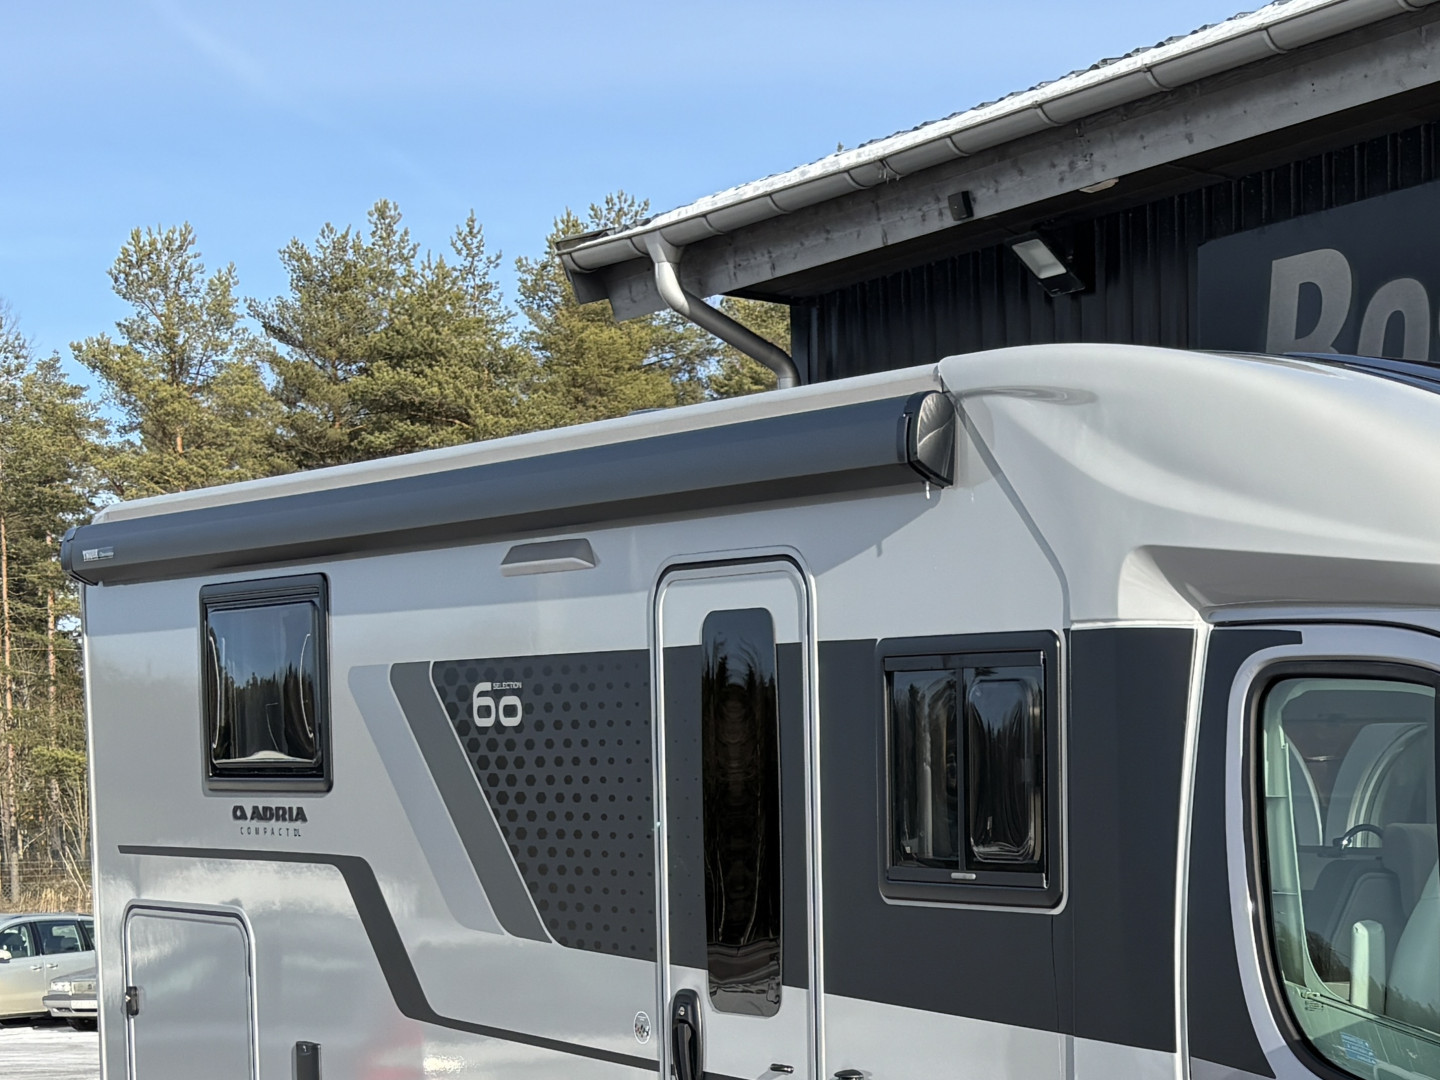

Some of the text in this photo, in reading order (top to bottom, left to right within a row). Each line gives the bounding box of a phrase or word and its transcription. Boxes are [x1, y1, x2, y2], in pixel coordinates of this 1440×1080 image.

[473, 682, 523, 727] 60
[250, 805, 308, 823] ADRIA
[240, 826, 290, 837] COMPACT
